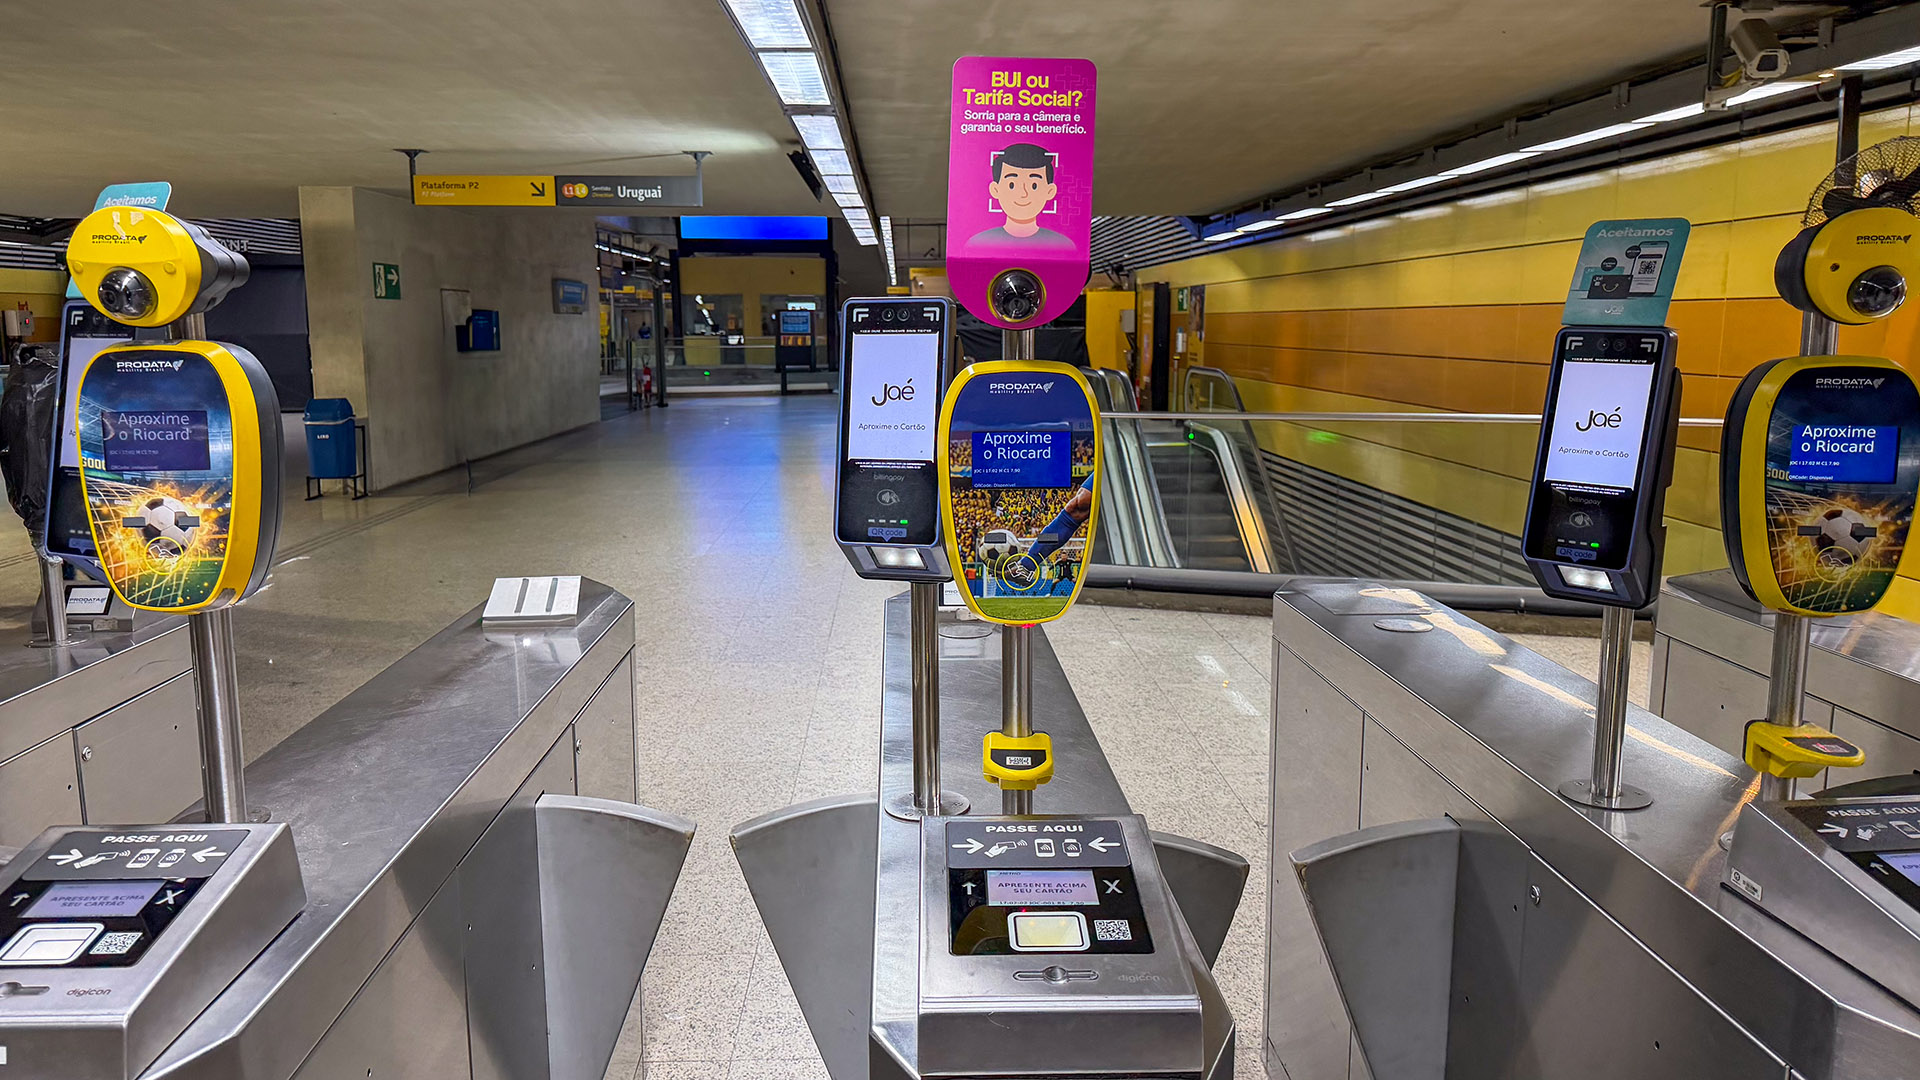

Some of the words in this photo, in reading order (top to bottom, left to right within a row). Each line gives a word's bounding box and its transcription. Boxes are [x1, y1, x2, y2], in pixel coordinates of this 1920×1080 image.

[992, 71, 1021, 88] BUI
[1026, 76, 1049, 88] ou
[962, 88, 1013, 106] Tarifa
[1018, 90, 1083, 107] Social?
[964, 110, 995, 121] Sorria
[998, 113, 1021, 123] para
[1023, 113, 1031, 122] a
[1032, 111, 1072, 122] câmera
[1073, 114, 1081, 122] e
[960, 123, 1002, 134] garanta
[1004, 125, 1012, 133] o
[1014, 124, 1034, 133] seu
[1036, 123, 1087, 134] benefício.
[421, 181, 466, 190] Plataforma
[468, 182, 480, 190] P2
[617, 185, 662, 202] Uruguai
[104, 195, 158, 206] Aceitamos
[1596, 227, 1675, 238] Aceitamos
[871, 378, 915, 406] Jaé
[118, 413, 190, 428] Aproxime
[1575, 406, 1622, 432] Jaé
[858, 423, 892, 431] Aproxime
[1802, 425, 1877, 439] Aproxime
[119, 431, 128, 440] o
[134, 428, 190, 441] Riocard
[983, 432, 1052, 447] Aproxime
[1558, 446, 1594, 456] Aproxime
[1602, 450, 1630, 458] Cartão
[1801, 443, 1810, 452] o
[1816, 440, 1874, 453] Riocard
[984, 450, 993, 460] o
[998, 447, 1052, 460] Riocard
[1560, 548, 1572, 556] QR
[1574, 550, 1593, 558] code
[1827, 808, 1880, 818] PASSE
[985, 825, 1038, 833] PASSE
[1042, 825, 1084, 833] AQUI
[101, 834, 160, 843] PASSE
[162, 834, 208, 843] AQUI
[1118, 974, 1160, 984] digicon
[66, 987, 112, 998] digicon
